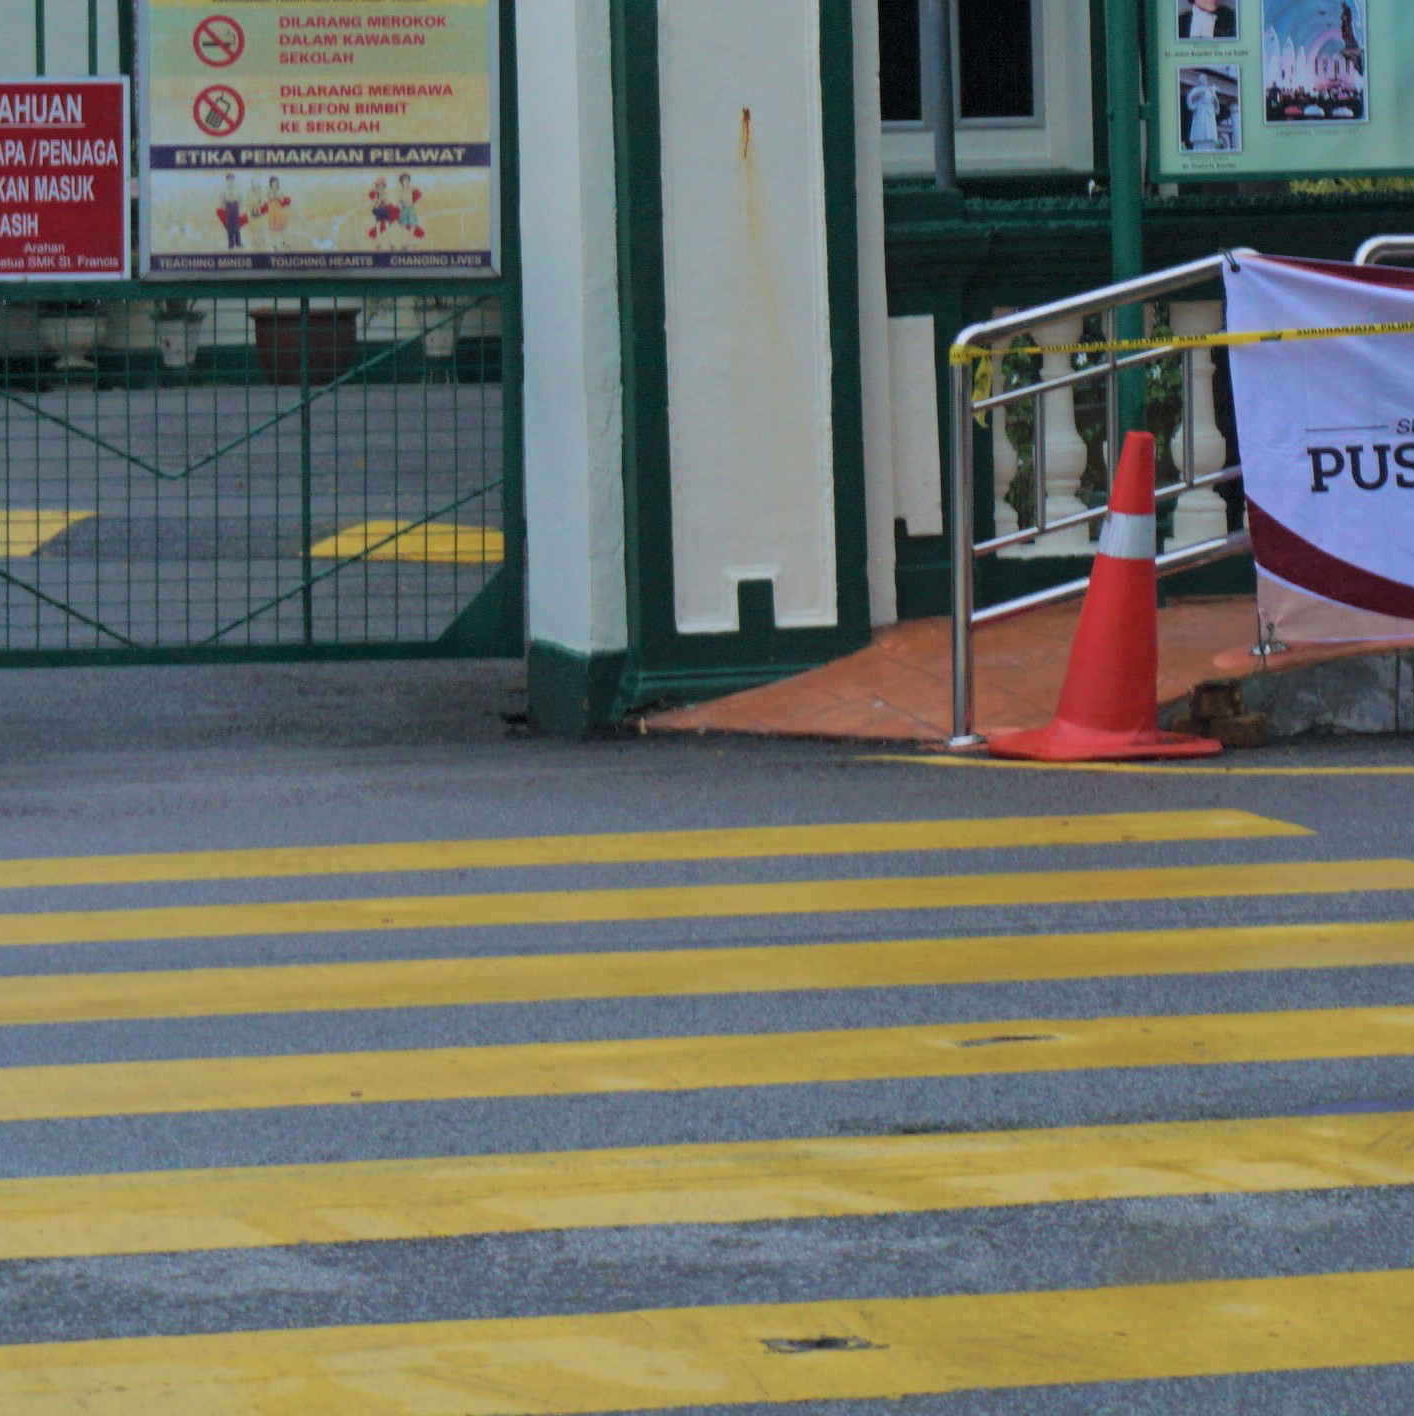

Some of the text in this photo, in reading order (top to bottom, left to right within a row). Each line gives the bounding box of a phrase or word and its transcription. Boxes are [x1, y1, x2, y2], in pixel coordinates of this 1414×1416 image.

[279, 15, 447, 29] DILARANG MEROKOK
[279, 34, 426, 47] DALAM KAWASAN
[279, 51, 354, 65] SEKOLAH
[280, 84, 453, 97] DILARANG MEMBAWA
[280, 102, 408, 115] TELEFON BIMBIT
[280, 120, 380, 133] KE SEKOLAH
[39, 138, 119, 166] PENJAGA
[175, 148, 466, 165] ETIKA PEMAKAIAN PELAWAT
[34, 175, 95, 202] MASUK
[24, 242, 66, 254] Arahan
[28, 256, 55, 268] SMK
[77, 255, 119, 268] Francis
[159, 257, 253, 269] TEACHING MINDS
[269, 256, 373, 268] TOUCHING HEARTS
[390, 255, 482, 267] CHANGING LIVES
